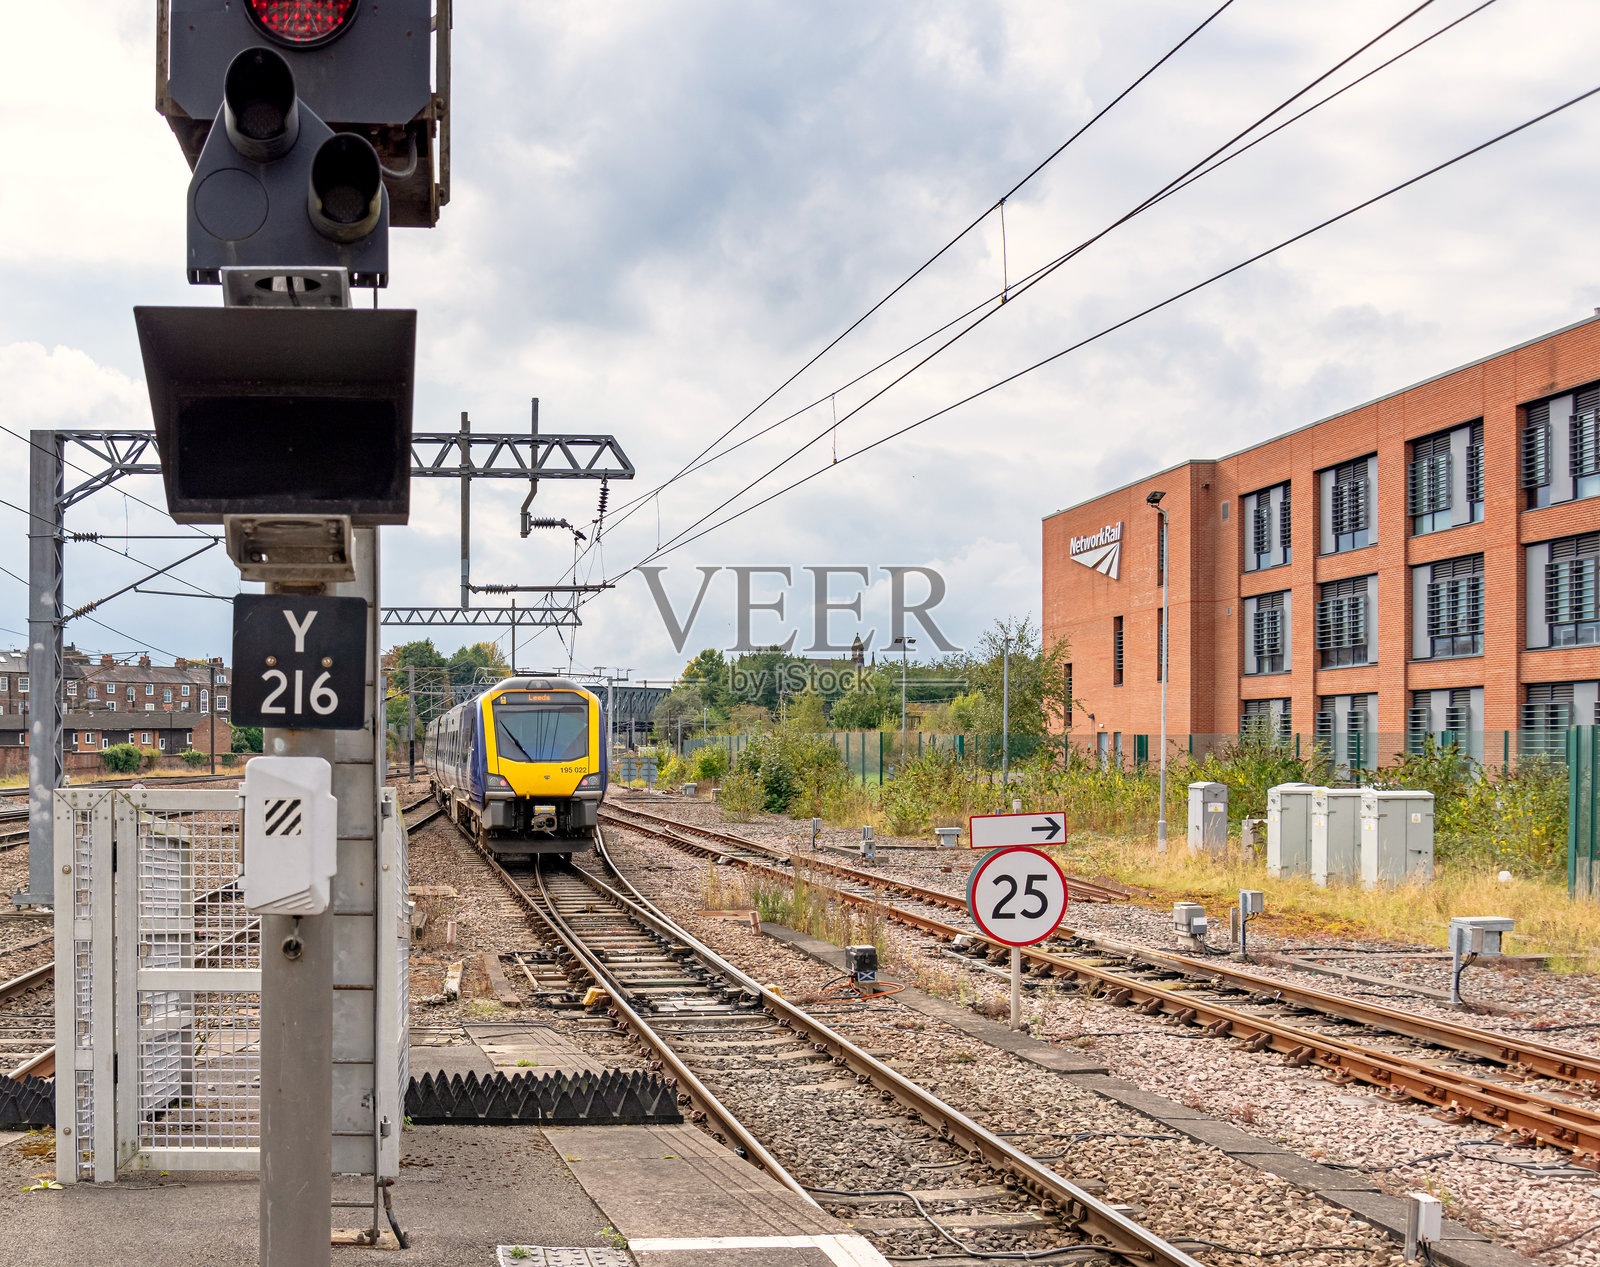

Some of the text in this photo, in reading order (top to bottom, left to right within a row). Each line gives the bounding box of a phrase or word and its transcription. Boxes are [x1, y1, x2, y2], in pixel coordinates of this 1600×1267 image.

[282, 610, 319, 653] Y
[260, 669, 339, 715] 216
[992, 874, 1048, 919] 25
